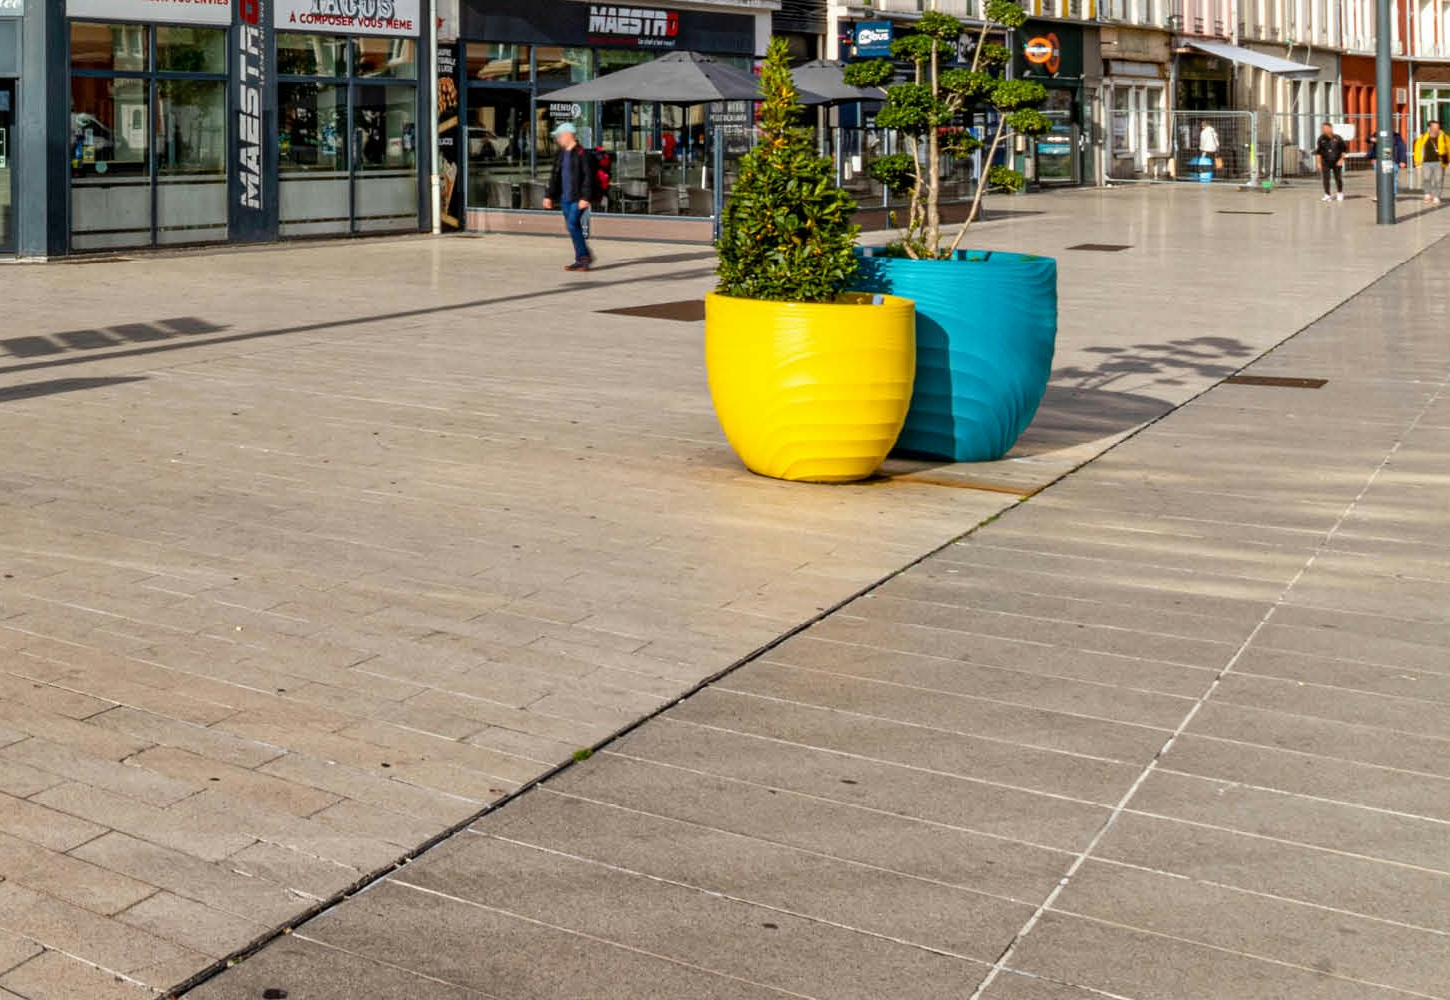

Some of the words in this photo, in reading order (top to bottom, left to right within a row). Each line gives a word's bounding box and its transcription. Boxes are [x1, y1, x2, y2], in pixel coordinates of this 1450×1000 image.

[300, 13, 354, 26] COMPOSER
[358, 17, 383, 28] VOUS
[589, 6, 678, 36] MAESTRO
[550, 103, 571, 111] MENU
